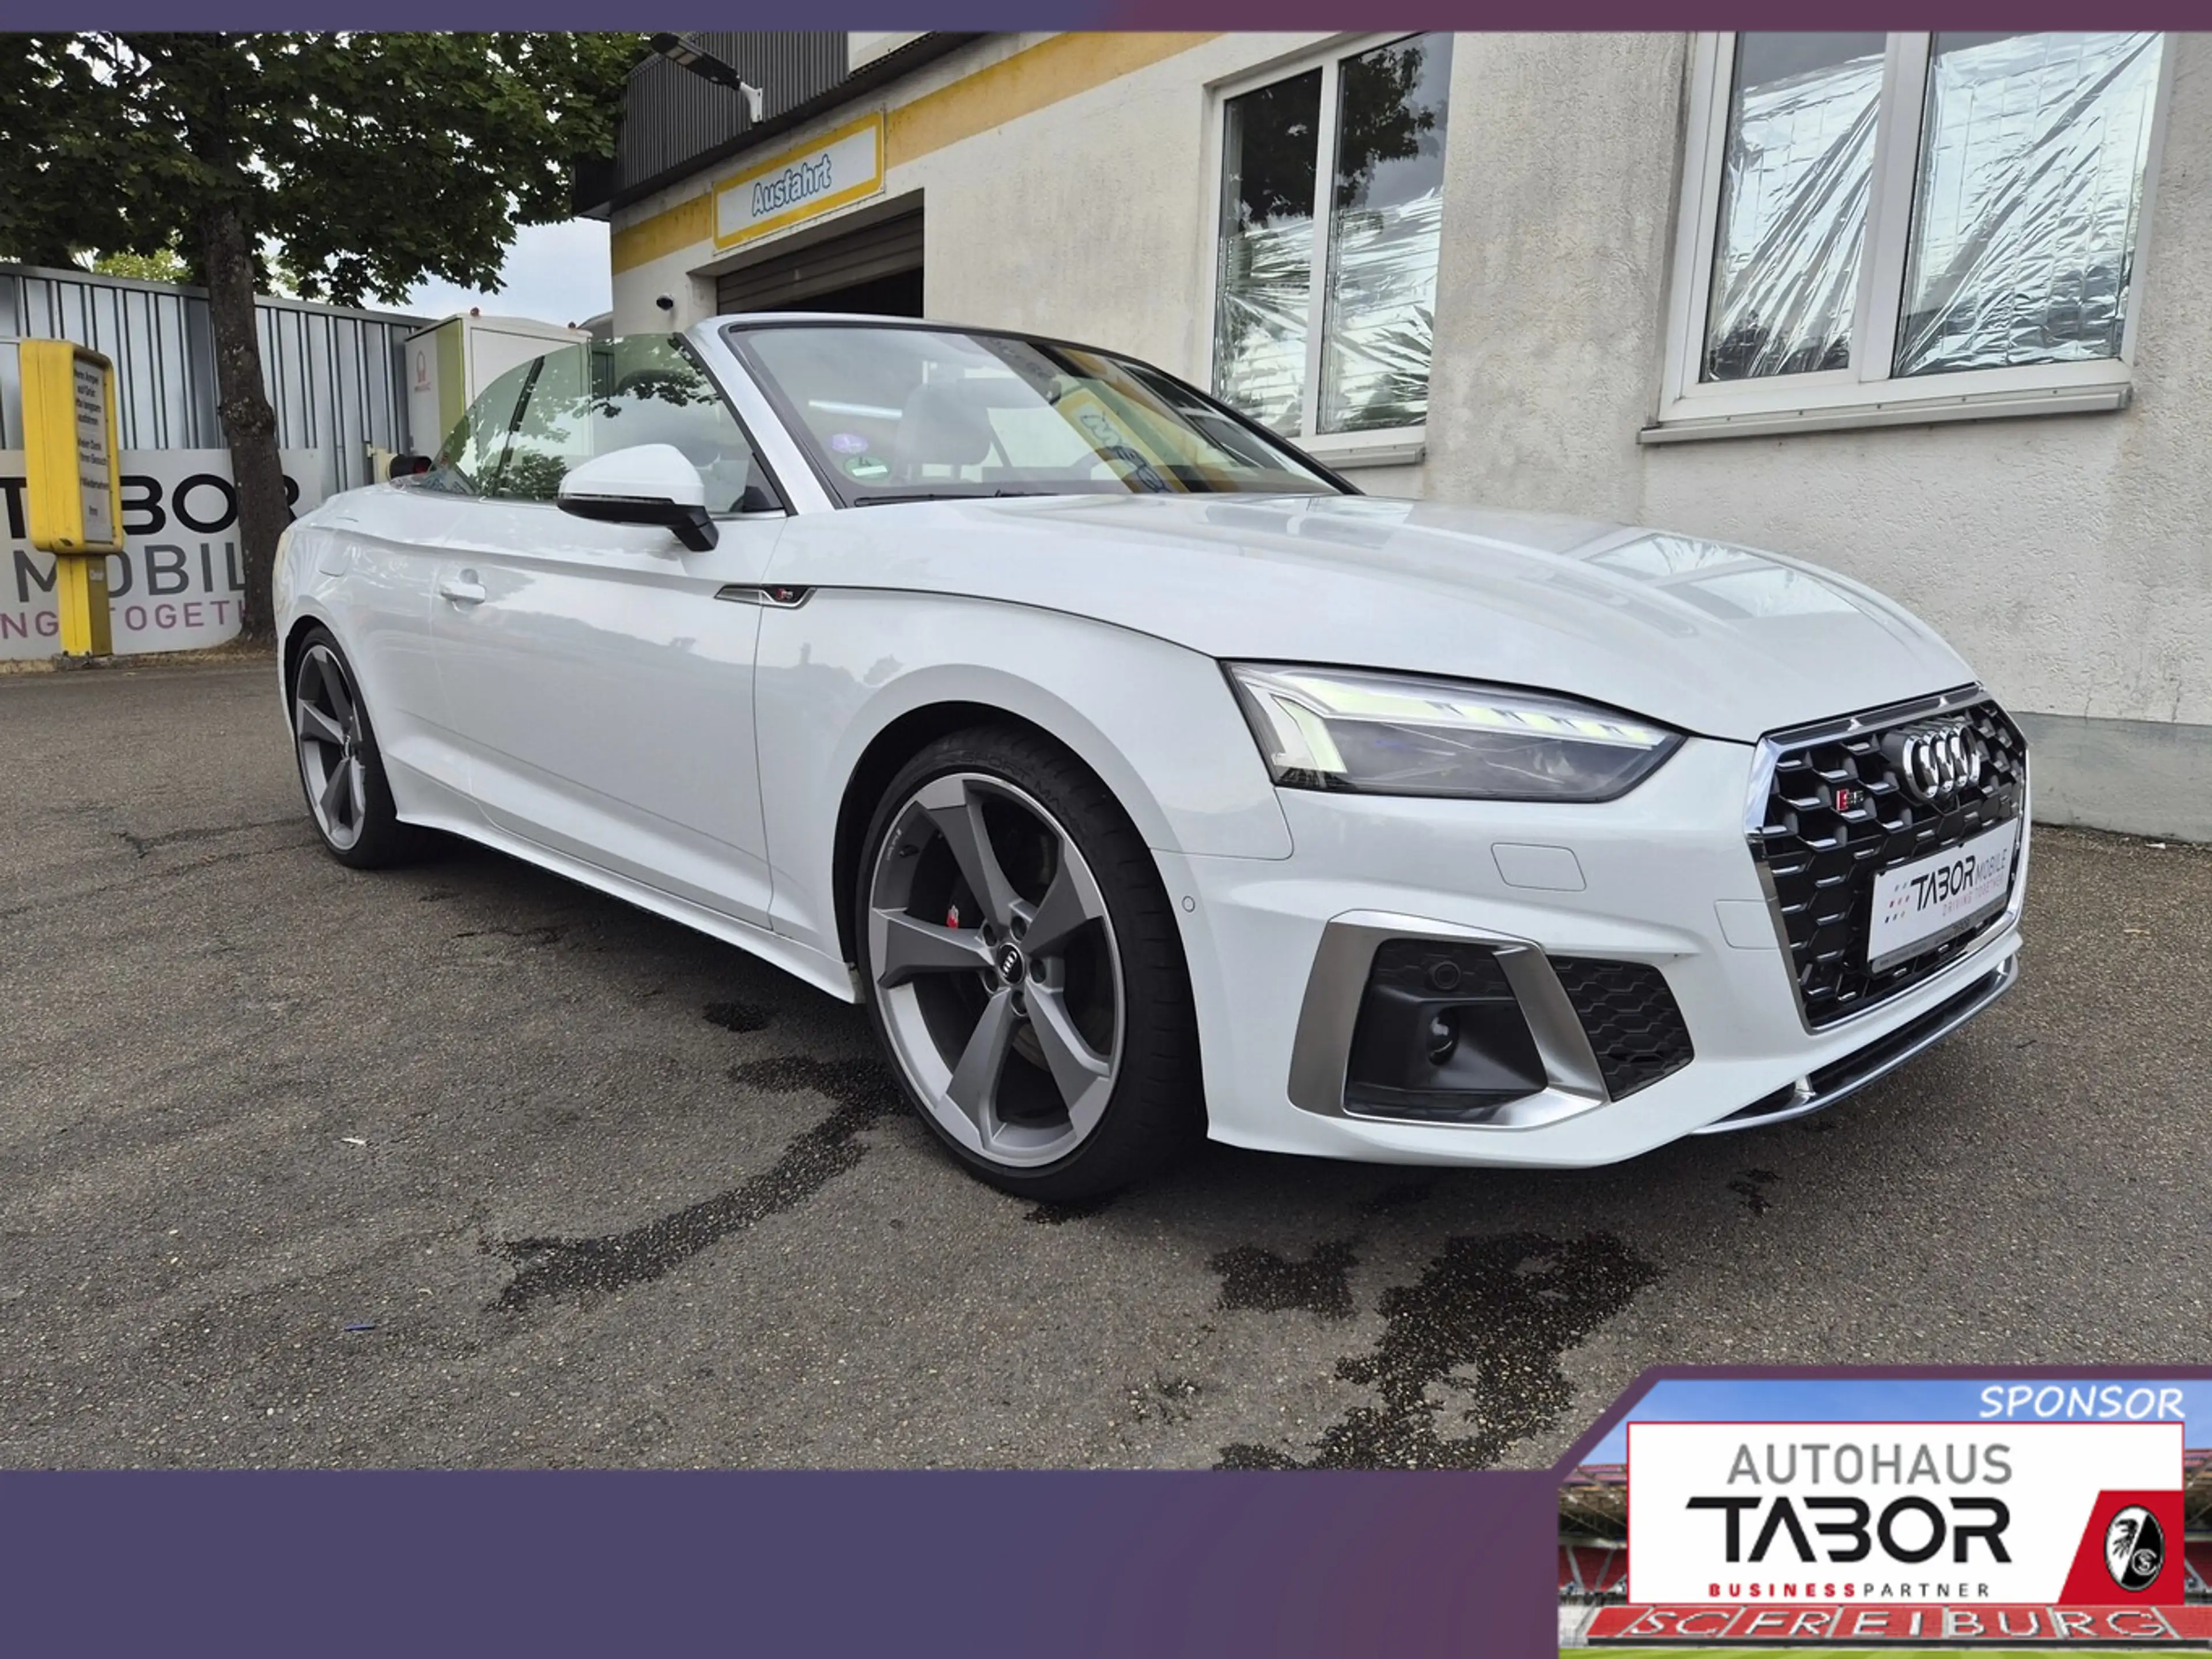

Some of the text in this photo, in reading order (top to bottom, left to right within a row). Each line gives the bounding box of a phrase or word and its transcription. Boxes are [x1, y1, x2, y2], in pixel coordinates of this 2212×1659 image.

[752, 153, 831, 217] Ausfahrt
[0, 474, 299, 539] TBO
[14, 543, 245, 602] MOBIL
[1911, 855, 1976, 911] TABOR
